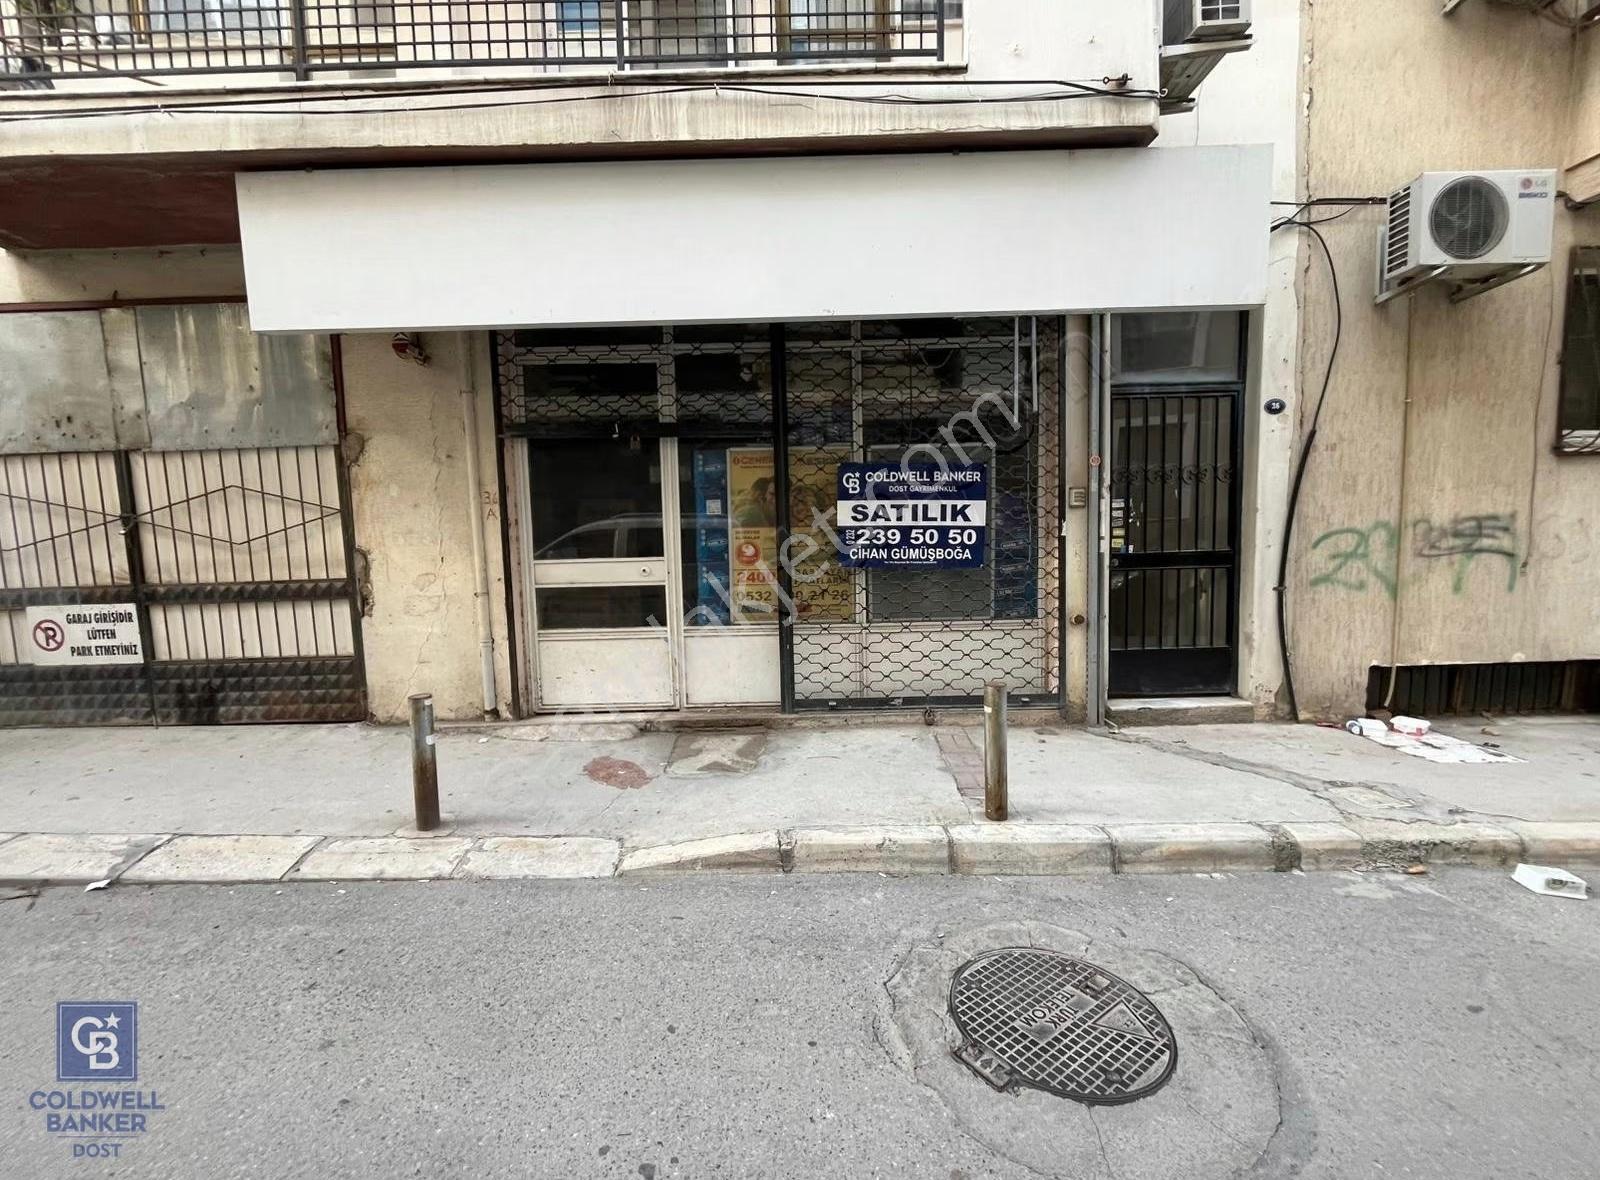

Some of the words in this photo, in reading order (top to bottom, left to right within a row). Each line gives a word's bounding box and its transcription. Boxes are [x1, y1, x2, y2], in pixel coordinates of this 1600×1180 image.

[865, 471, 930, 482] COLDWELL
[933, 471, 981, 482] BANKER
[850, 503, 972, 522] SATILIK
[856, 528, 901, 545] 239
[909, 528, 938, 545] 50
[947, 528, 977, 545] 50
[849, 546, 888, 560] CİHAN
[891, 545, 972, 561] GÜMÜŞBOĞA
[66, 612, 93, 624] GARAJ
[93, 609, 134, 624] GİRİŞİDİR
[87, 626, 117, 640] LÜTFEN
[70, 645, 94, 657] PARK
[95, 642, 139, 657] ETMEYİNİZ
[1020, 989, 1076, 1028] TELEKOM
